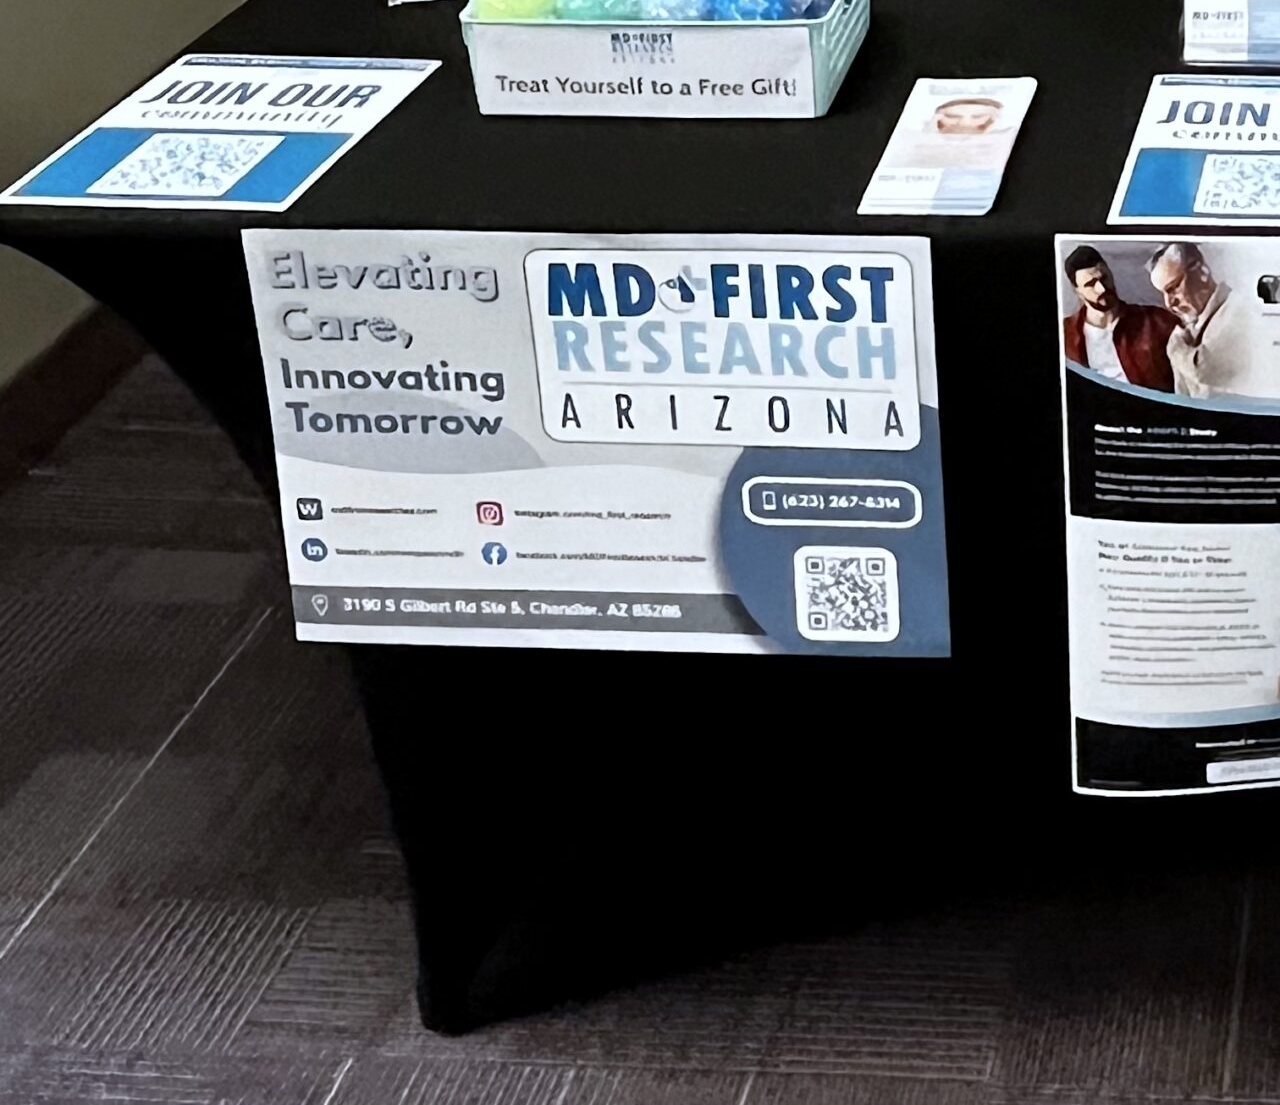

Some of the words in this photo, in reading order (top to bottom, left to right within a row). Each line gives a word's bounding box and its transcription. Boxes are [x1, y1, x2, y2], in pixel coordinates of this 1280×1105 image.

[138, 79, 270, 106] JOIN
[267, 83, 382, 109] OUR
[495, 75, 550, 94] Treat
[555, 75, 644, 96] Yourself
[651, 79, 674, 95] to
[679, 82, 693, 96] a
[699, 79, 744, 96] Free
[751, 78, 797, 97] Gift!
[1156, 99, 1271, 128] JOIN
[270, 249, 499, 303] Elevating
[548, 262, 657, 318] MD
[710, 263, 895, 324] FIRST
[278, 301, 413, 349] Care,
[552, 320, 897, 381] RESEARCH
[279, 357, 506, 402] Innovating
[285, 401, 504, 436] Tomorrow
[561, 392, 905, 438] ARIZONA
[385, 598, 397, 613] S
[455, 599, 477, 614] Rd
[606, 602, 629, 618] AZ
